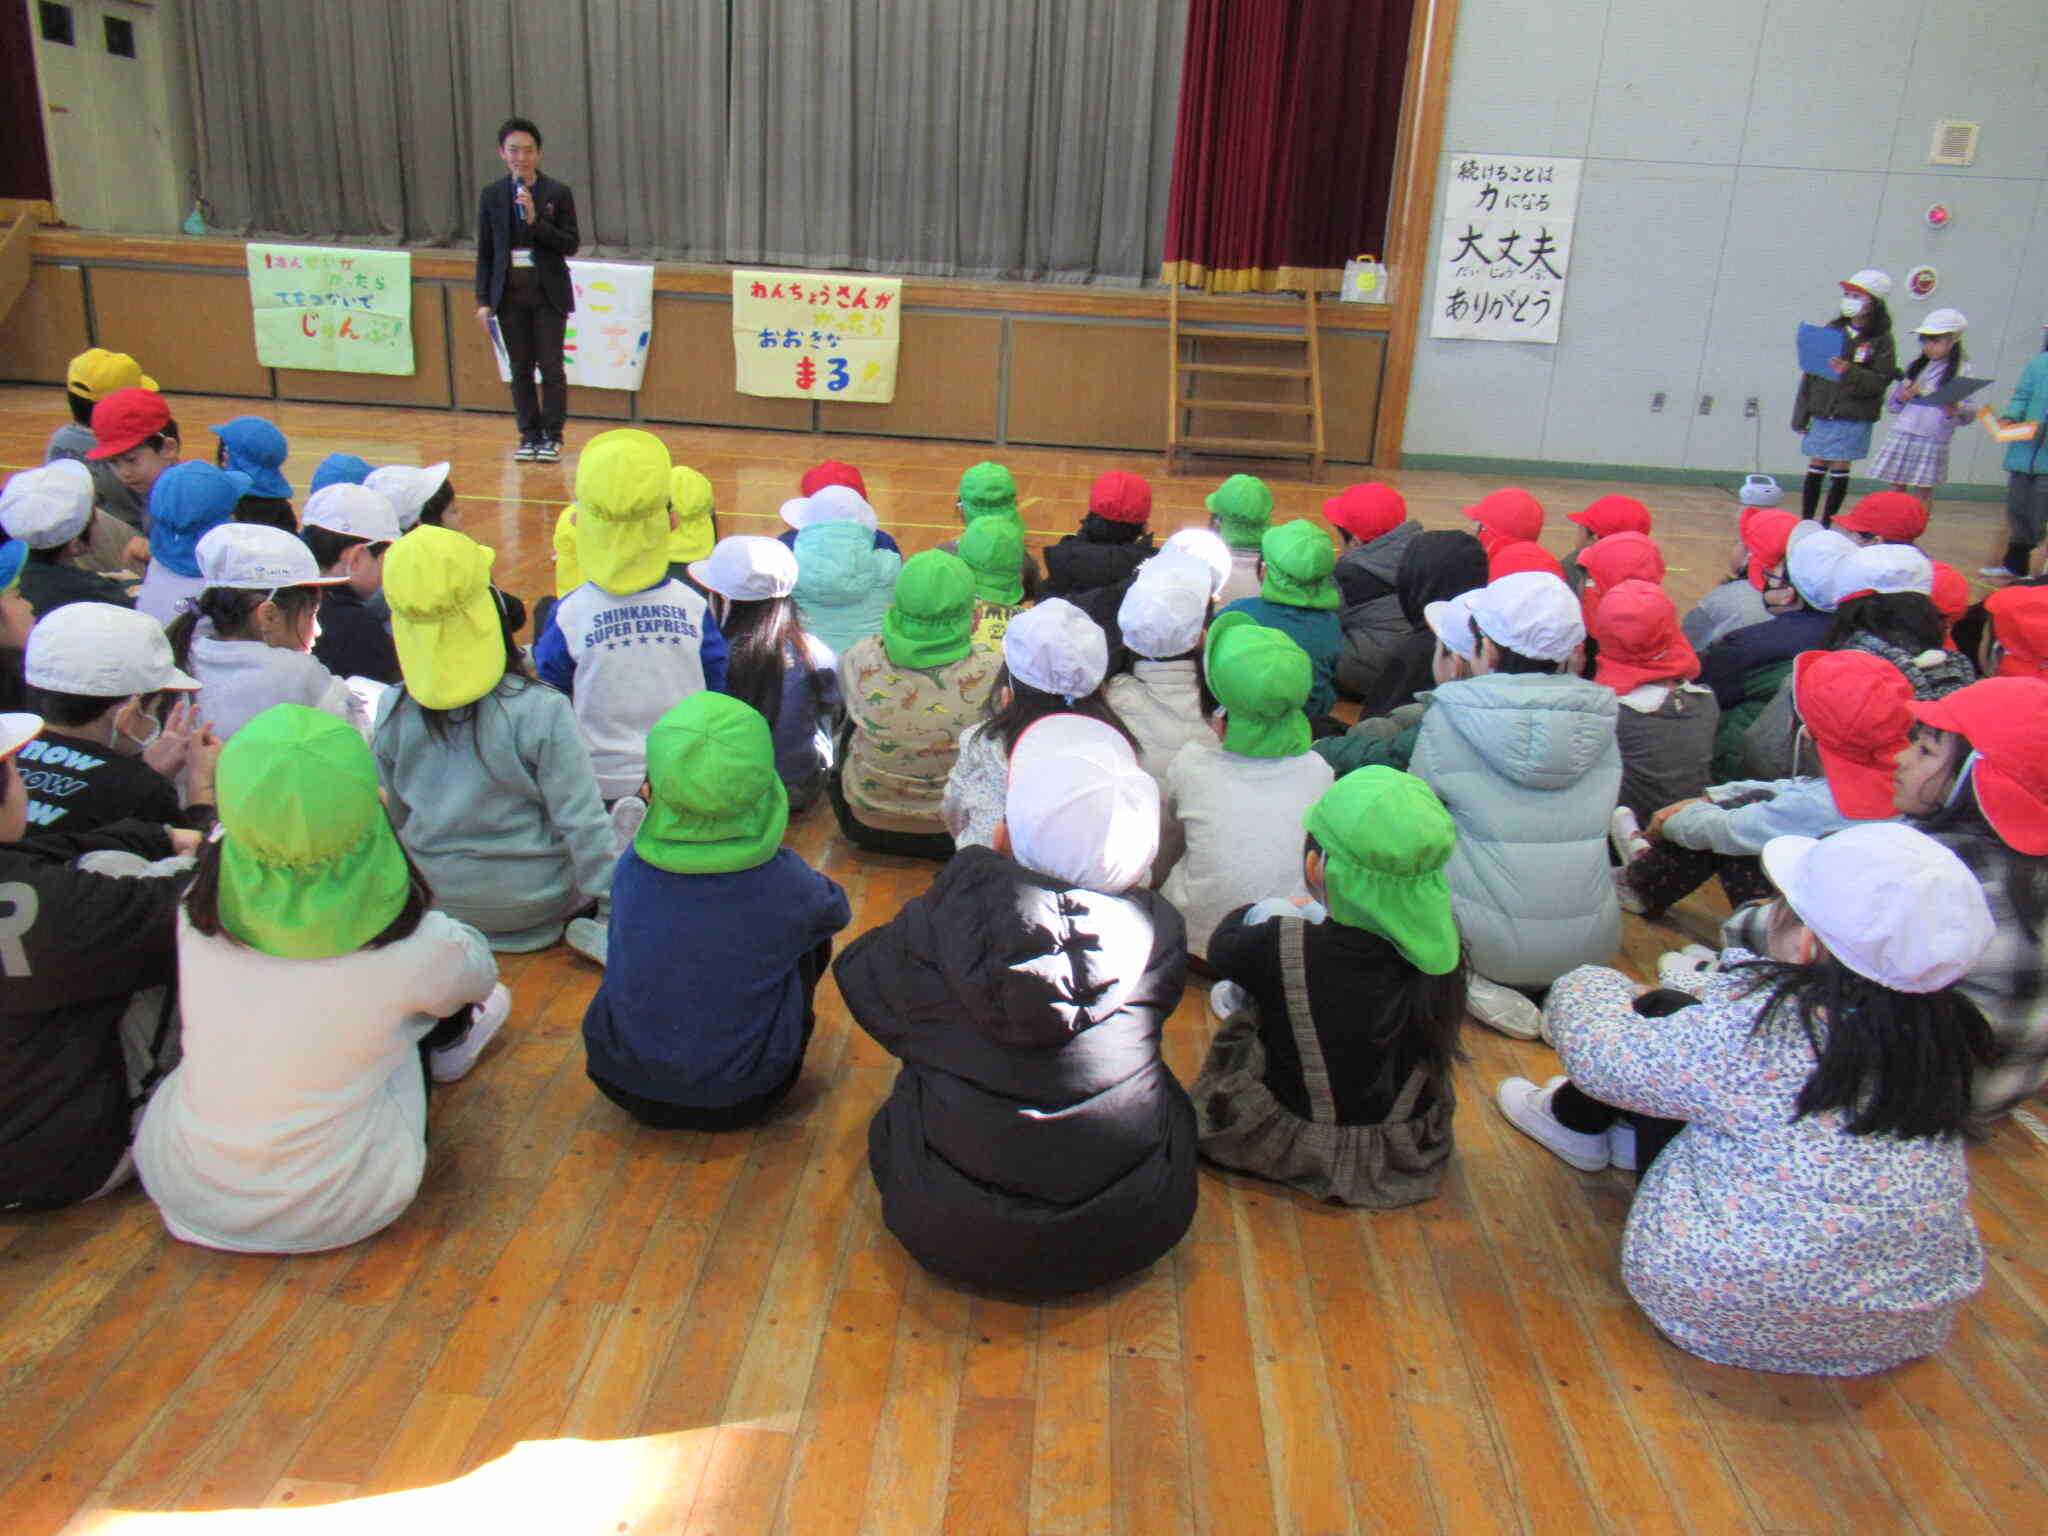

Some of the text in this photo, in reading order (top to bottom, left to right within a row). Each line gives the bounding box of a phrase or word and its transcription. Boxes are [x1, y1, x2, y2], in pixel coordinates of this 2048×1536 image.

[1456, 159, 1555, 183] 続けることは
[1475, 182, 1551, 212] 力になる
[1449, 223, 1563, 280] 大丈夫
[1445, 286, 1552, 328] ありがとう
[757, 327, 842, 350] おおきな
[592, 603, 688, 629] SHINKANSEN
[584, 618, 699, 648] SUPER EXPRESS
